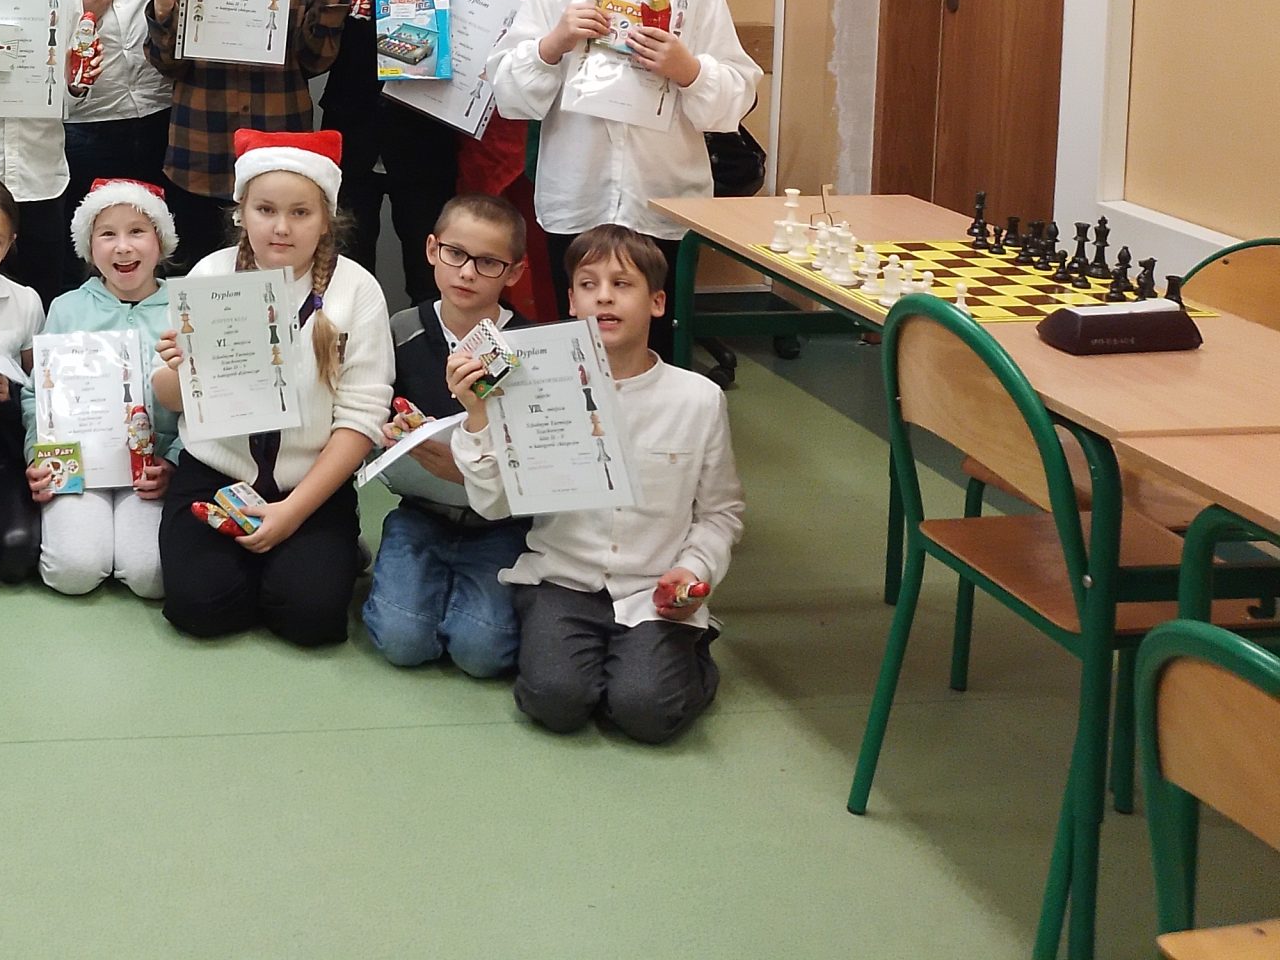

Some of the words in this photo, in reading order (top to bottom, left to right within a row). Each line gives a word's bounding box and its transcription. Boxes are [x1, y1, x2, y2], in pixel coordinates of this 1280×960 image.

[210, 290, 241, 300] Dyplom
[516, 347, 548, 359] Dyplom
[37, 448, 53, 458] ALE
